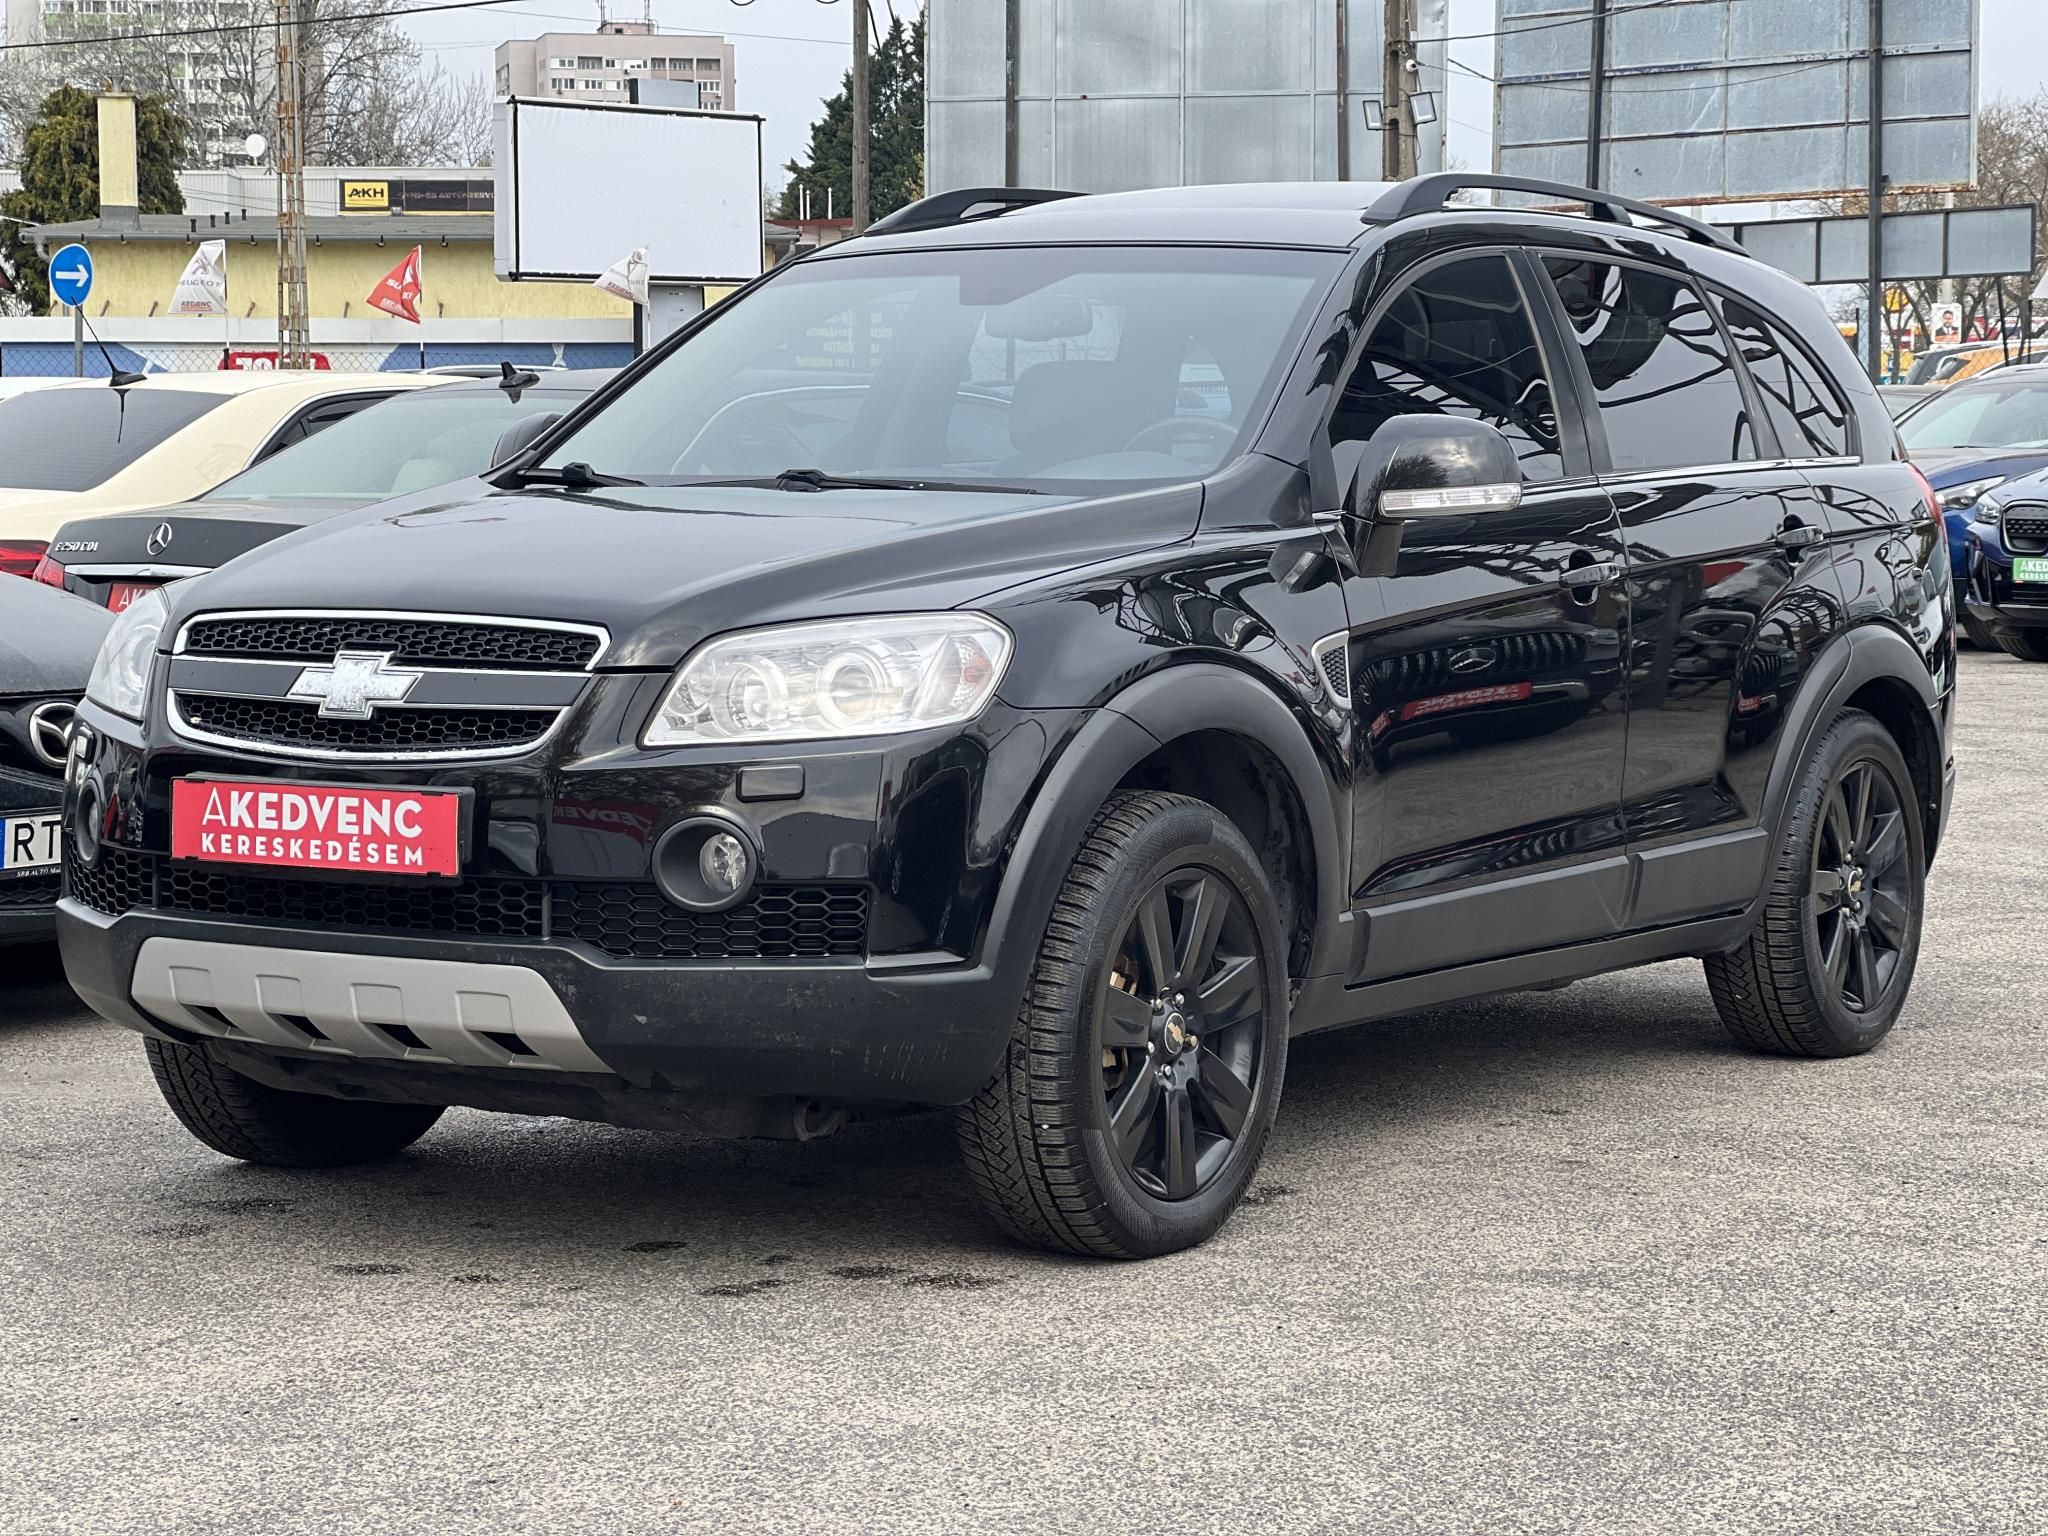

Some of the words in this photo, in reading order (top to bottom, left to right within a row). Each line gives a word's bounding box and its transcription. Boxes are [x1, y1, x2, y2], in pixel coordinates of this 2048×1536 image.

[348, 188, 384, 197] AKH
[202, 786, 423, 838] AKEDVENC
[13, 820, 62, 863] RT
[201, 832, 424, 867] KERESKEDÉSEM
